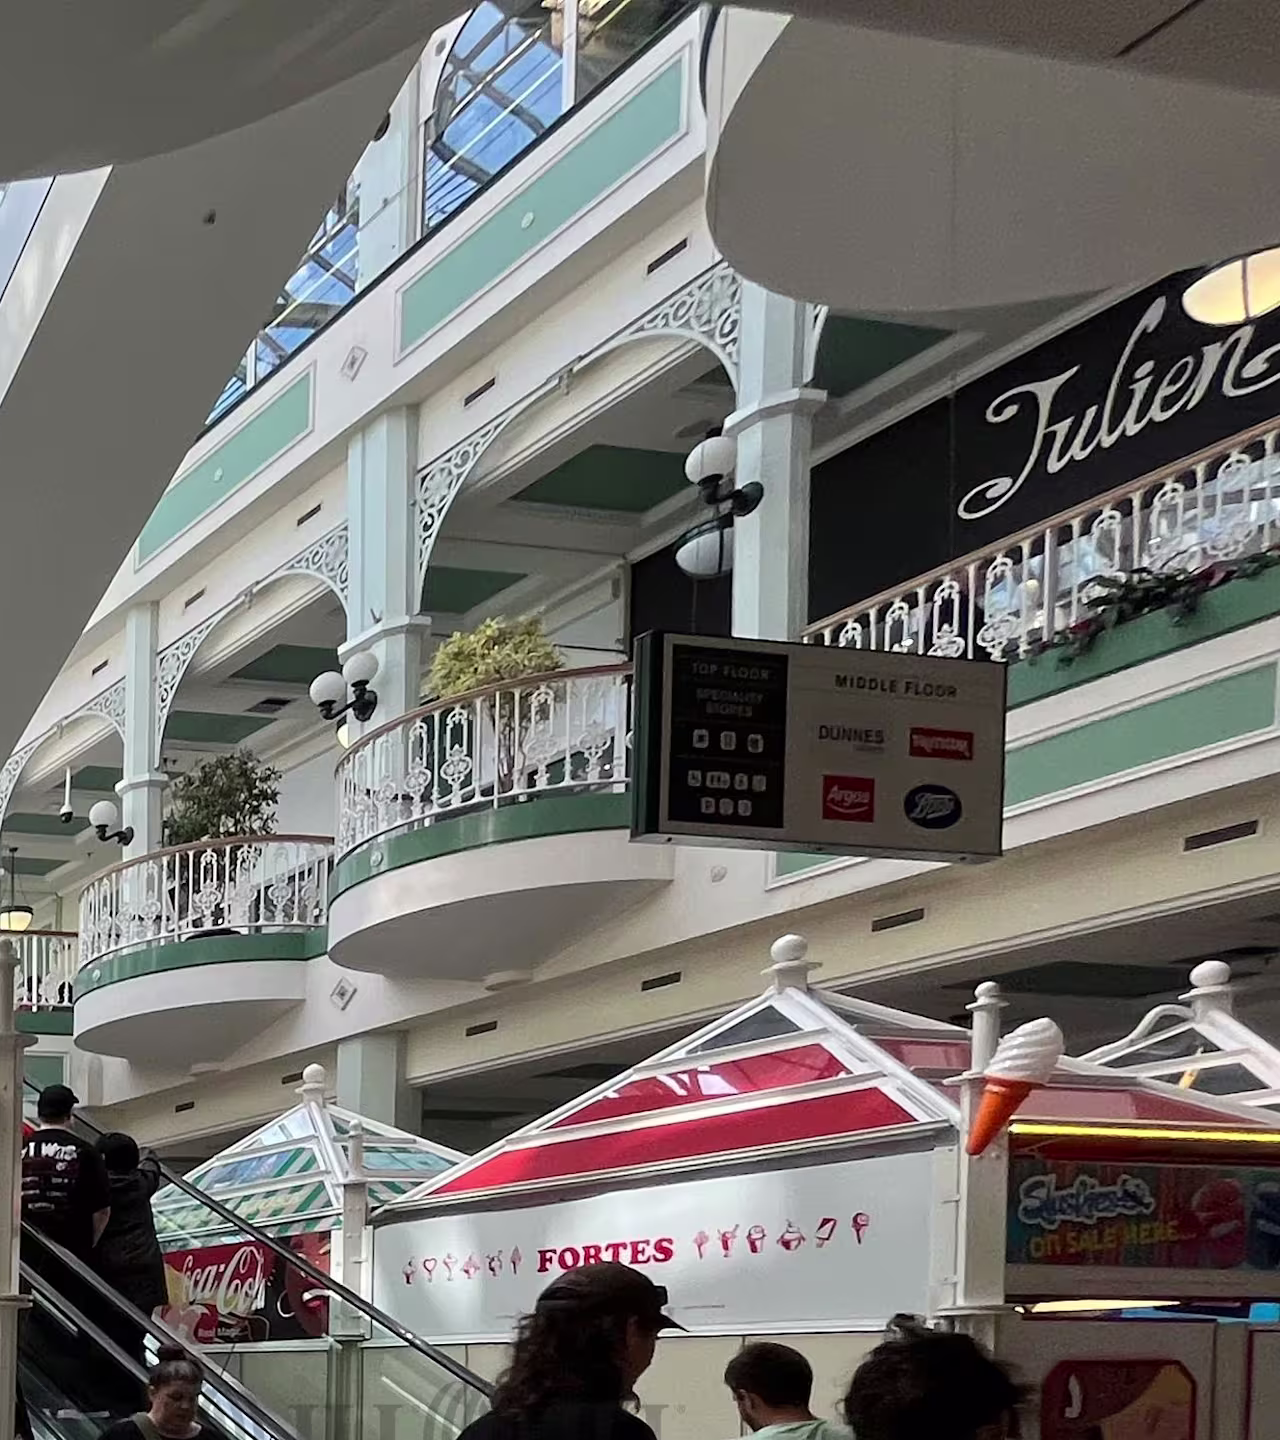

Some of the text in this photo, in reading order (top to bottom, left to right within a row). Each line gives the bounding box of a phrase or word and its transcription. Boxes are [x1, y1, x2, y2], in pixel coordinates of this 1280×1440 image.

[834, 674, 957, 698] MIDDLE FLOOR
[818, 725, 884, 745] DUNNES
[827, 784, 870, 807] Argos
[537, 1237, 674, 1273] FORTES
